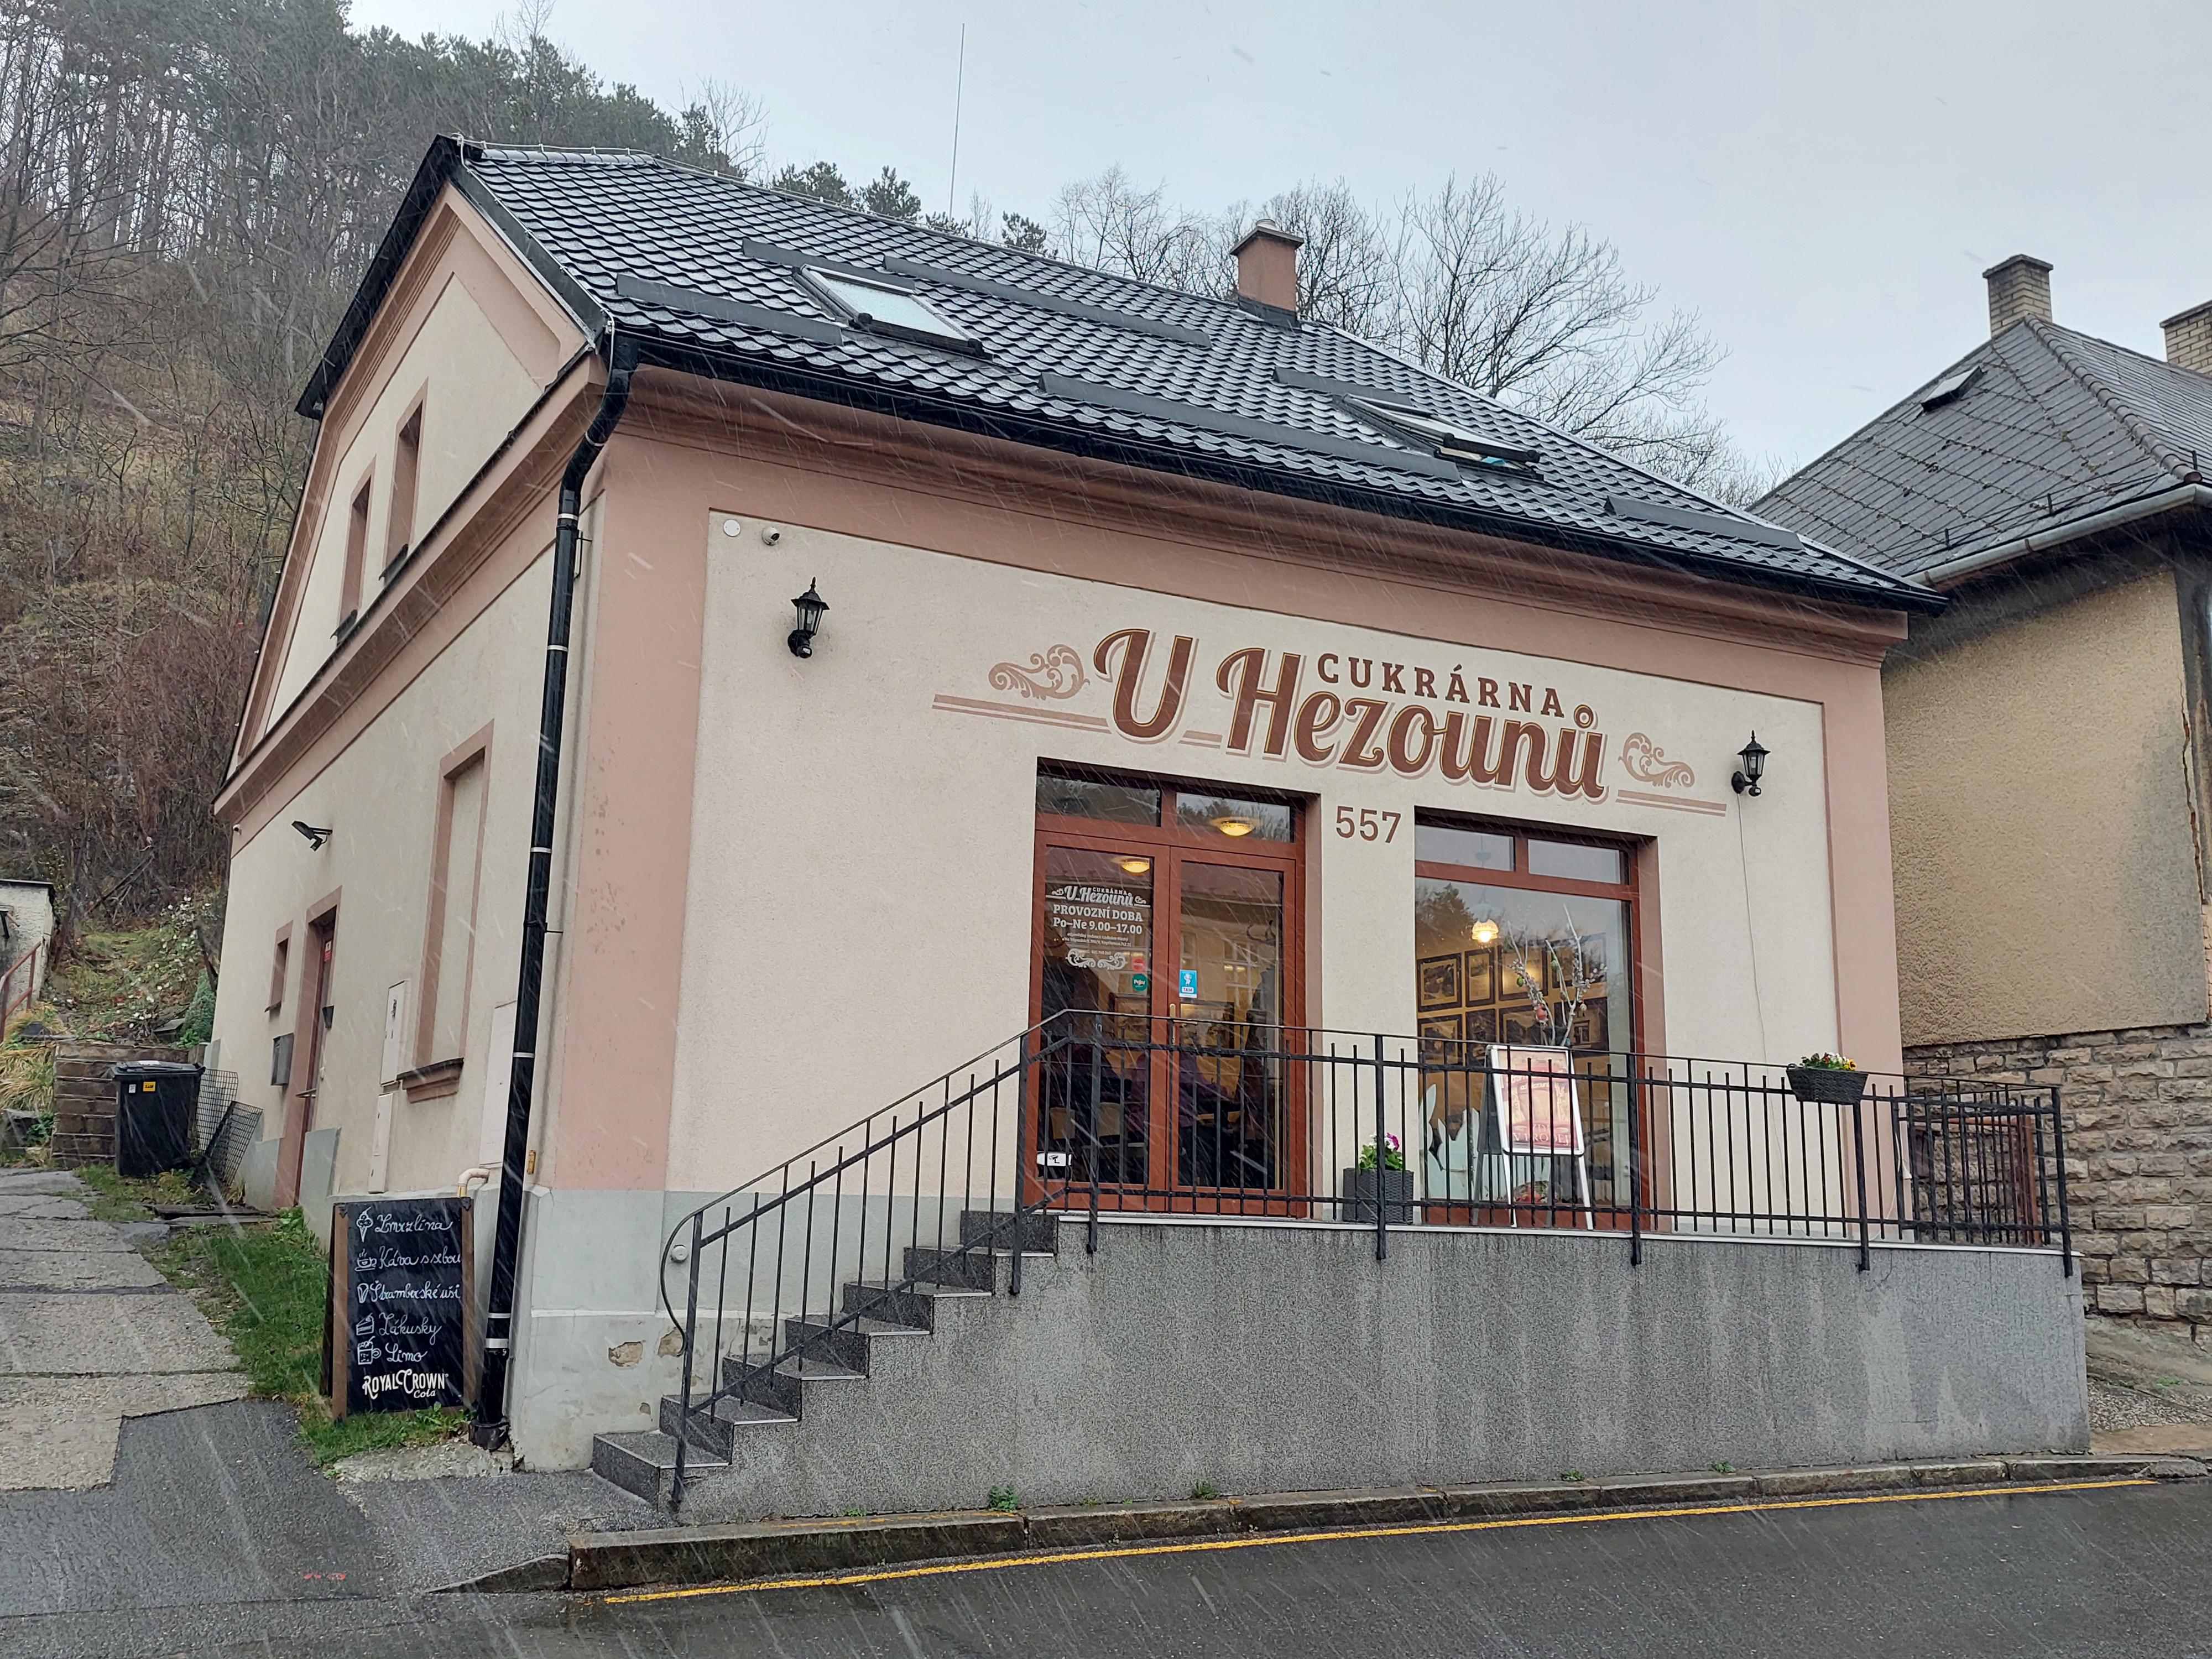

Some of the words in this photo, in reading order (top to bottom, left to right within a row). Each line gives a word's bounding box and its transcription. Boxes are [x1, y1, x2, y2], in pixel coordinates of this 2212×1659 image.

[1317, 653, 1565, 718] CUKRÁRNA
[1093, 628, 1197, 743] U
[1216, 648, 1606, 801] Hezounů
[1335, 805, 1401, 843] 557
[1064, 885, 1078, 901] U
[1053, 904, 1110, 919] PROVOZNÍ
[1112, 910, 1144, 922] DOBA
[379, 1245, 419, 1269] Káva
[370, 1280, 441, 1302] Štramberské
[440, 1284, 461, 1298] uši
[379, 1312, 442, 1345] Zákusky
[385, 1343, 428, 1362] Limo
[362, 1373, 399, 1400] ROYAL
[414, 1389, 436, 1398] Cola
